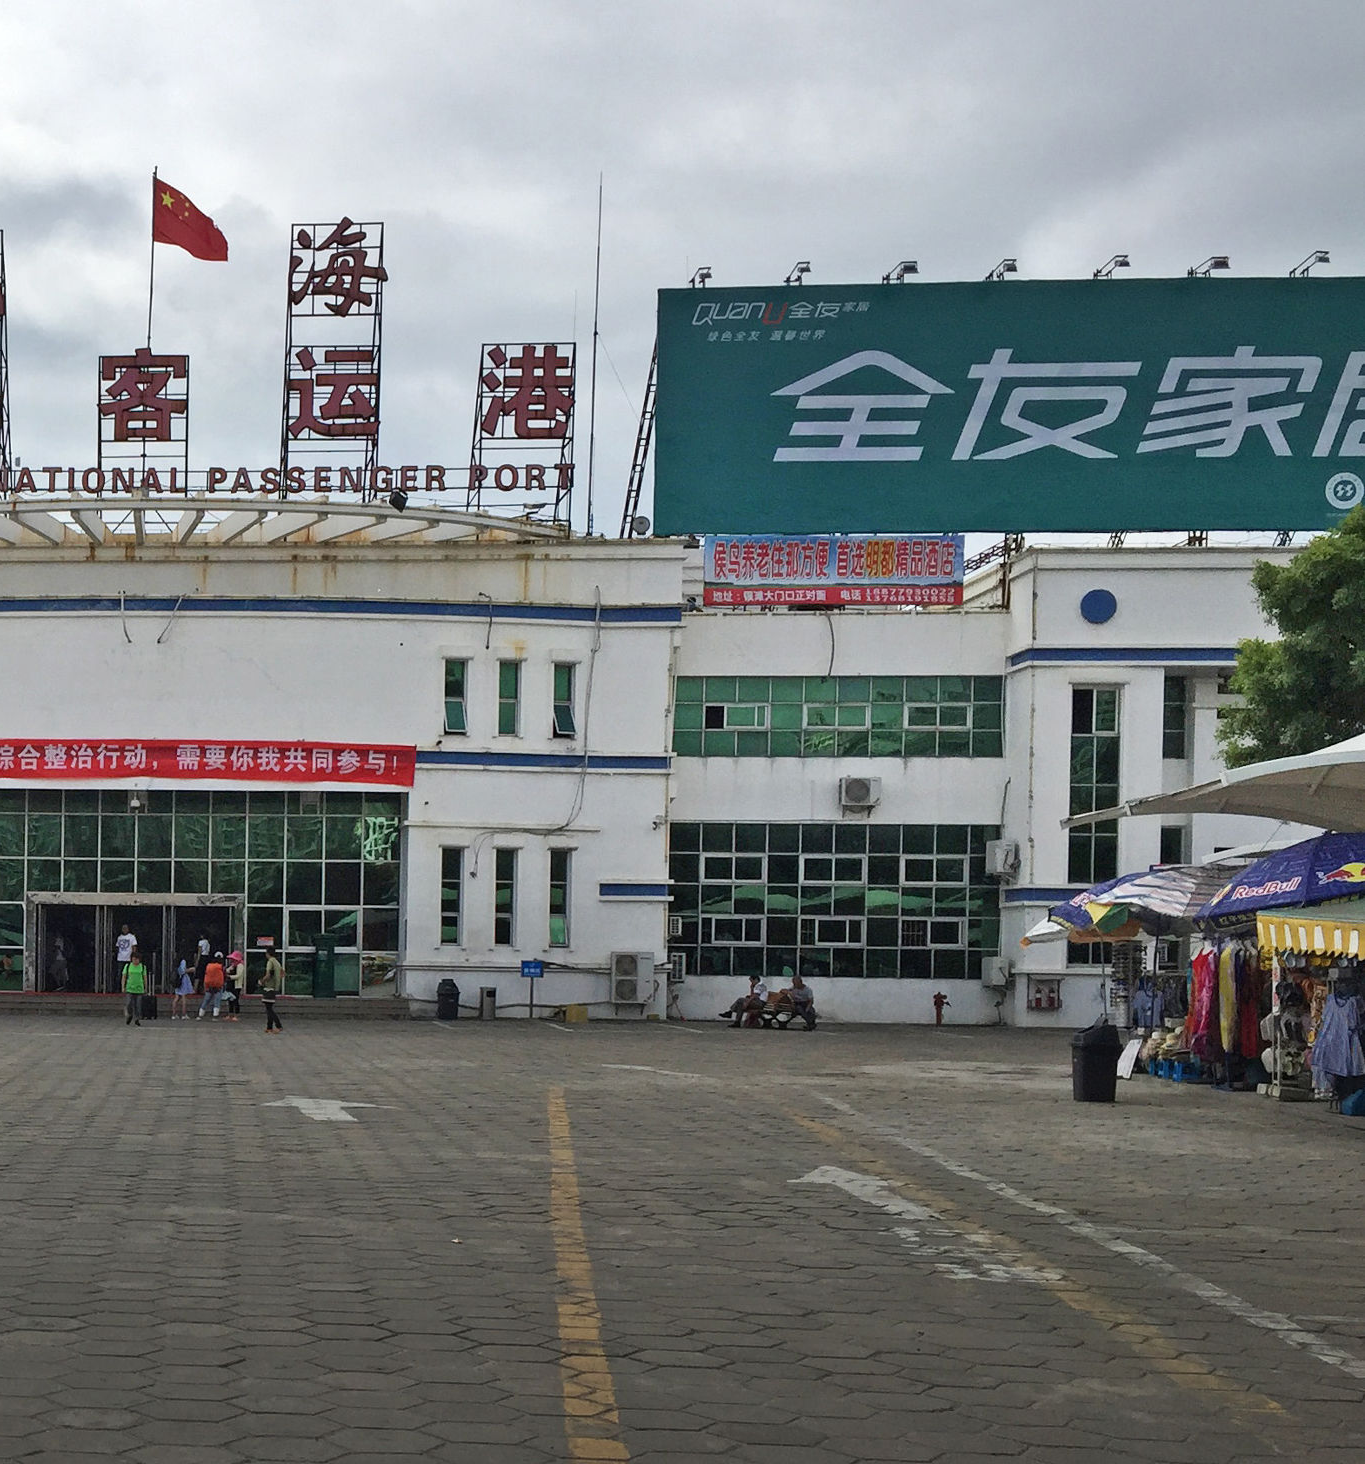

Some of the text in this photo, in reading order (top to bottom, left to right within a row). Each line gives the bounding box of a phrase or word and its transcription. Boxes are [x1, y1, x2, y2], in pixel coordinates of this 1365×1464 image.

[207, 465, 447, 494] PASSENGER
[469, 463, 575, 491] PORT
[836, 540, 956, 577] 首选明都精品酒店
[840, 589, 862, 601] 电话
